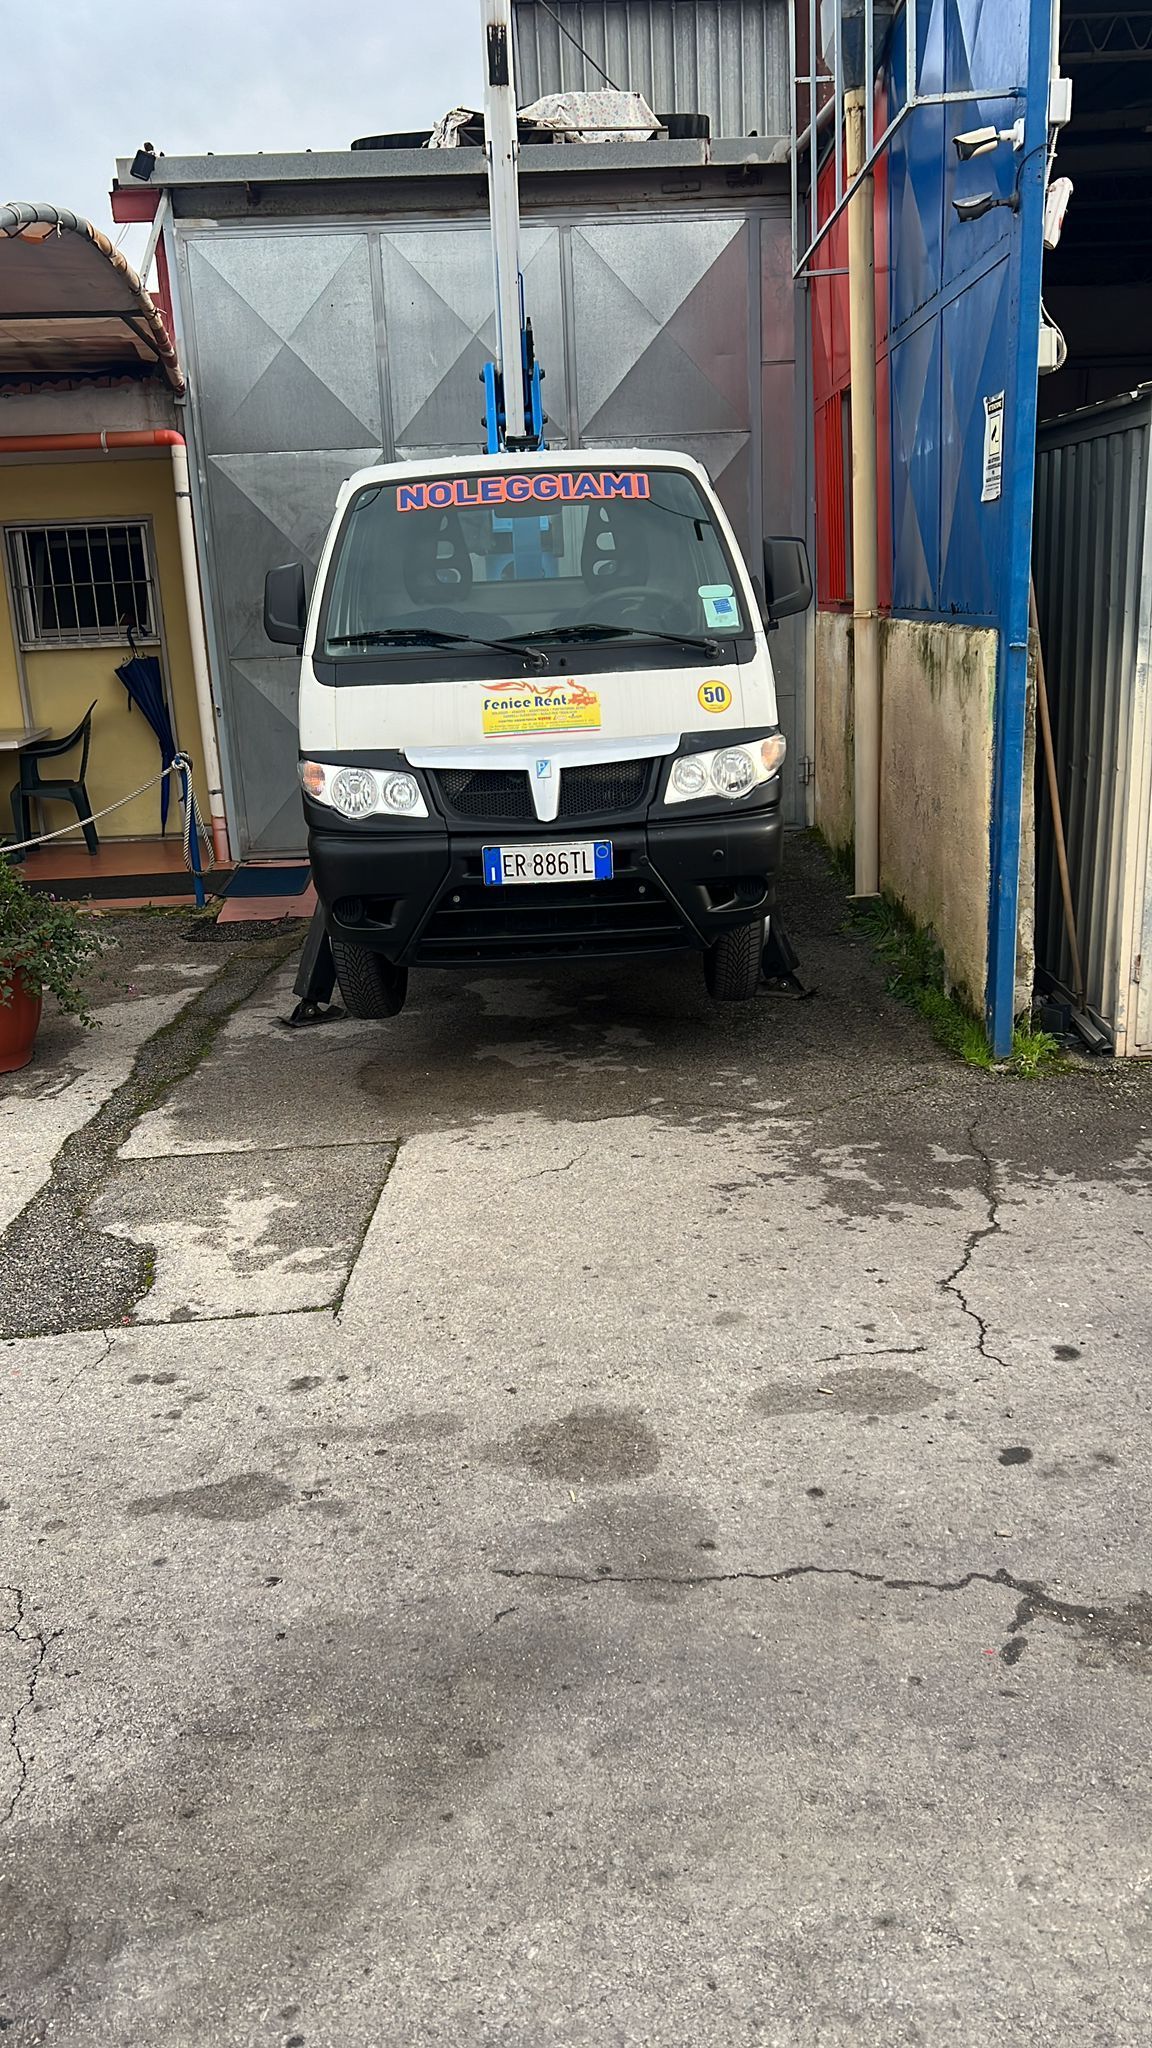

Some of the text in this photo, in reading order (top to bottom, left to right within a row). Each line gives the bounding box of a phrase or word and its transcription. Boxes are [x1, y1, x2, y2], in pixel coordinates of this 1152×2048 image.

[397, 473, 649, 512] NOLEGGIAMI
[484, 697, 532, 711] Fenice
[534, 694, 567, 708] Rent
[703, 686, 725, 704] 50
[502, 853, 527, 878] ER
[533, 851, 594, 877] 886TL
